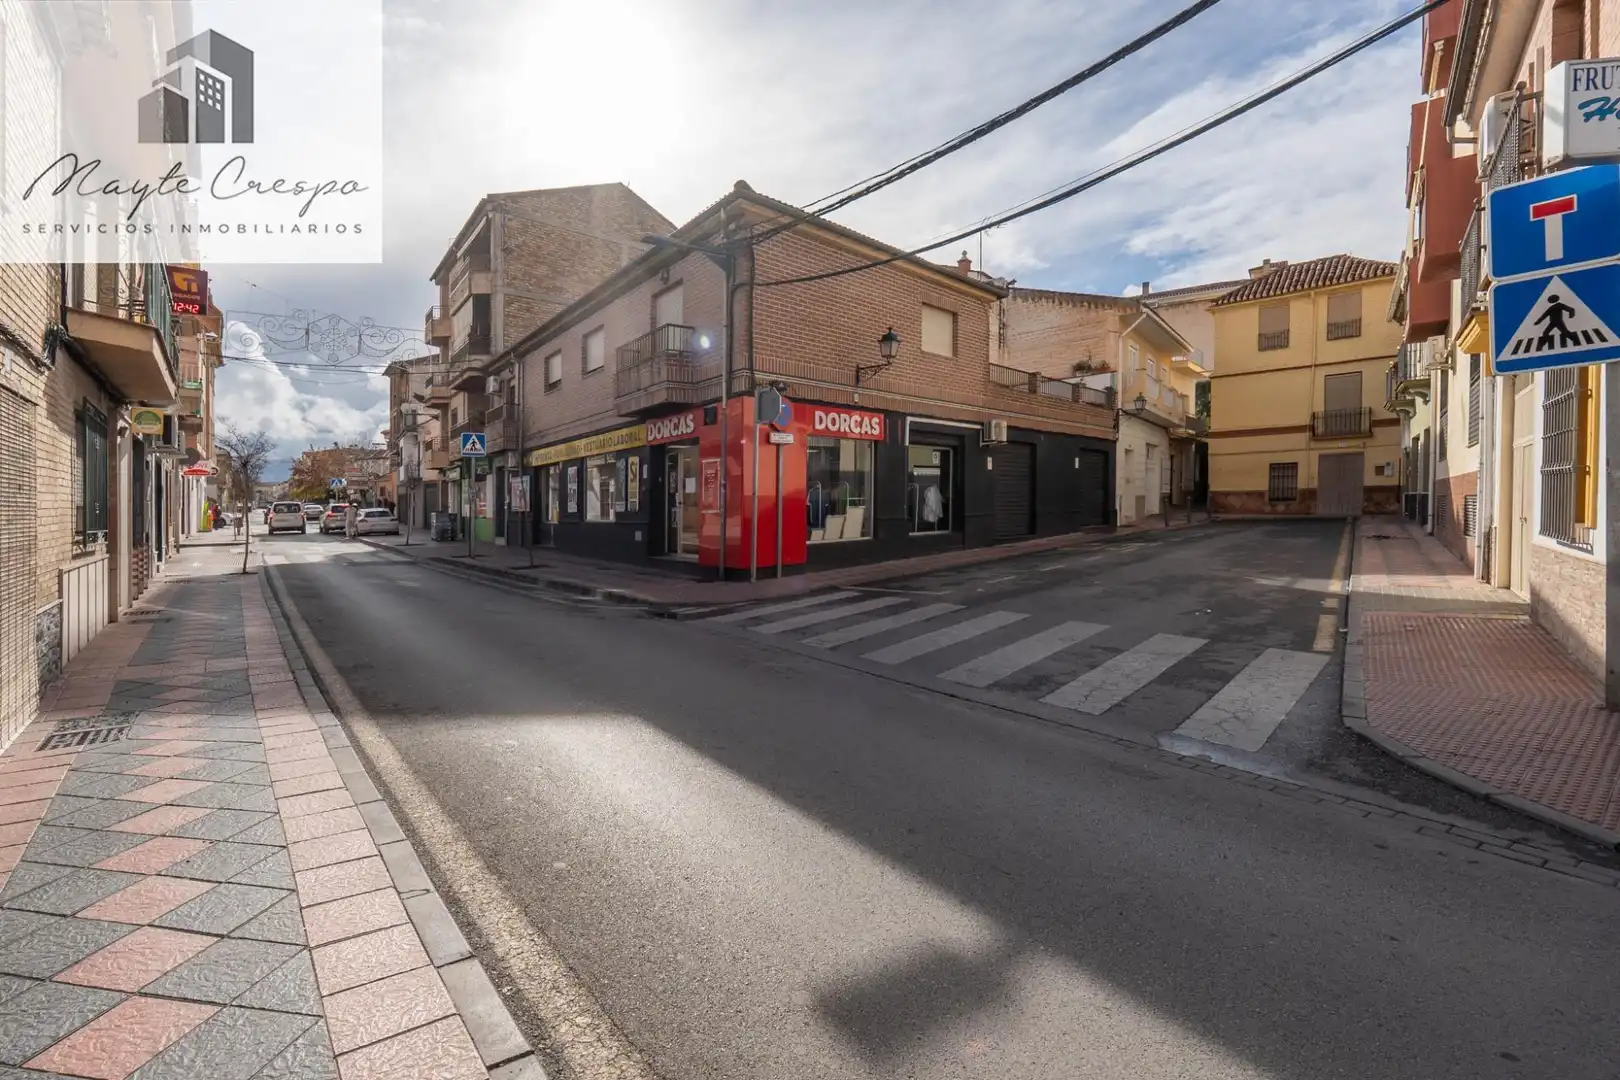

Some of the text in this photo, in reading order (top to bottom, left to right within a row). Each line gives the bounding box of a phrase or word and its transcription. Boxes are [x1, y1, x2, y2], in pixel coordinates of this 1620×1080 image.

[174, 302, 200, 314] 12:42
[647, 413, 695, 441] DORCAS
[814, 410, 880, 435] DORCAS
